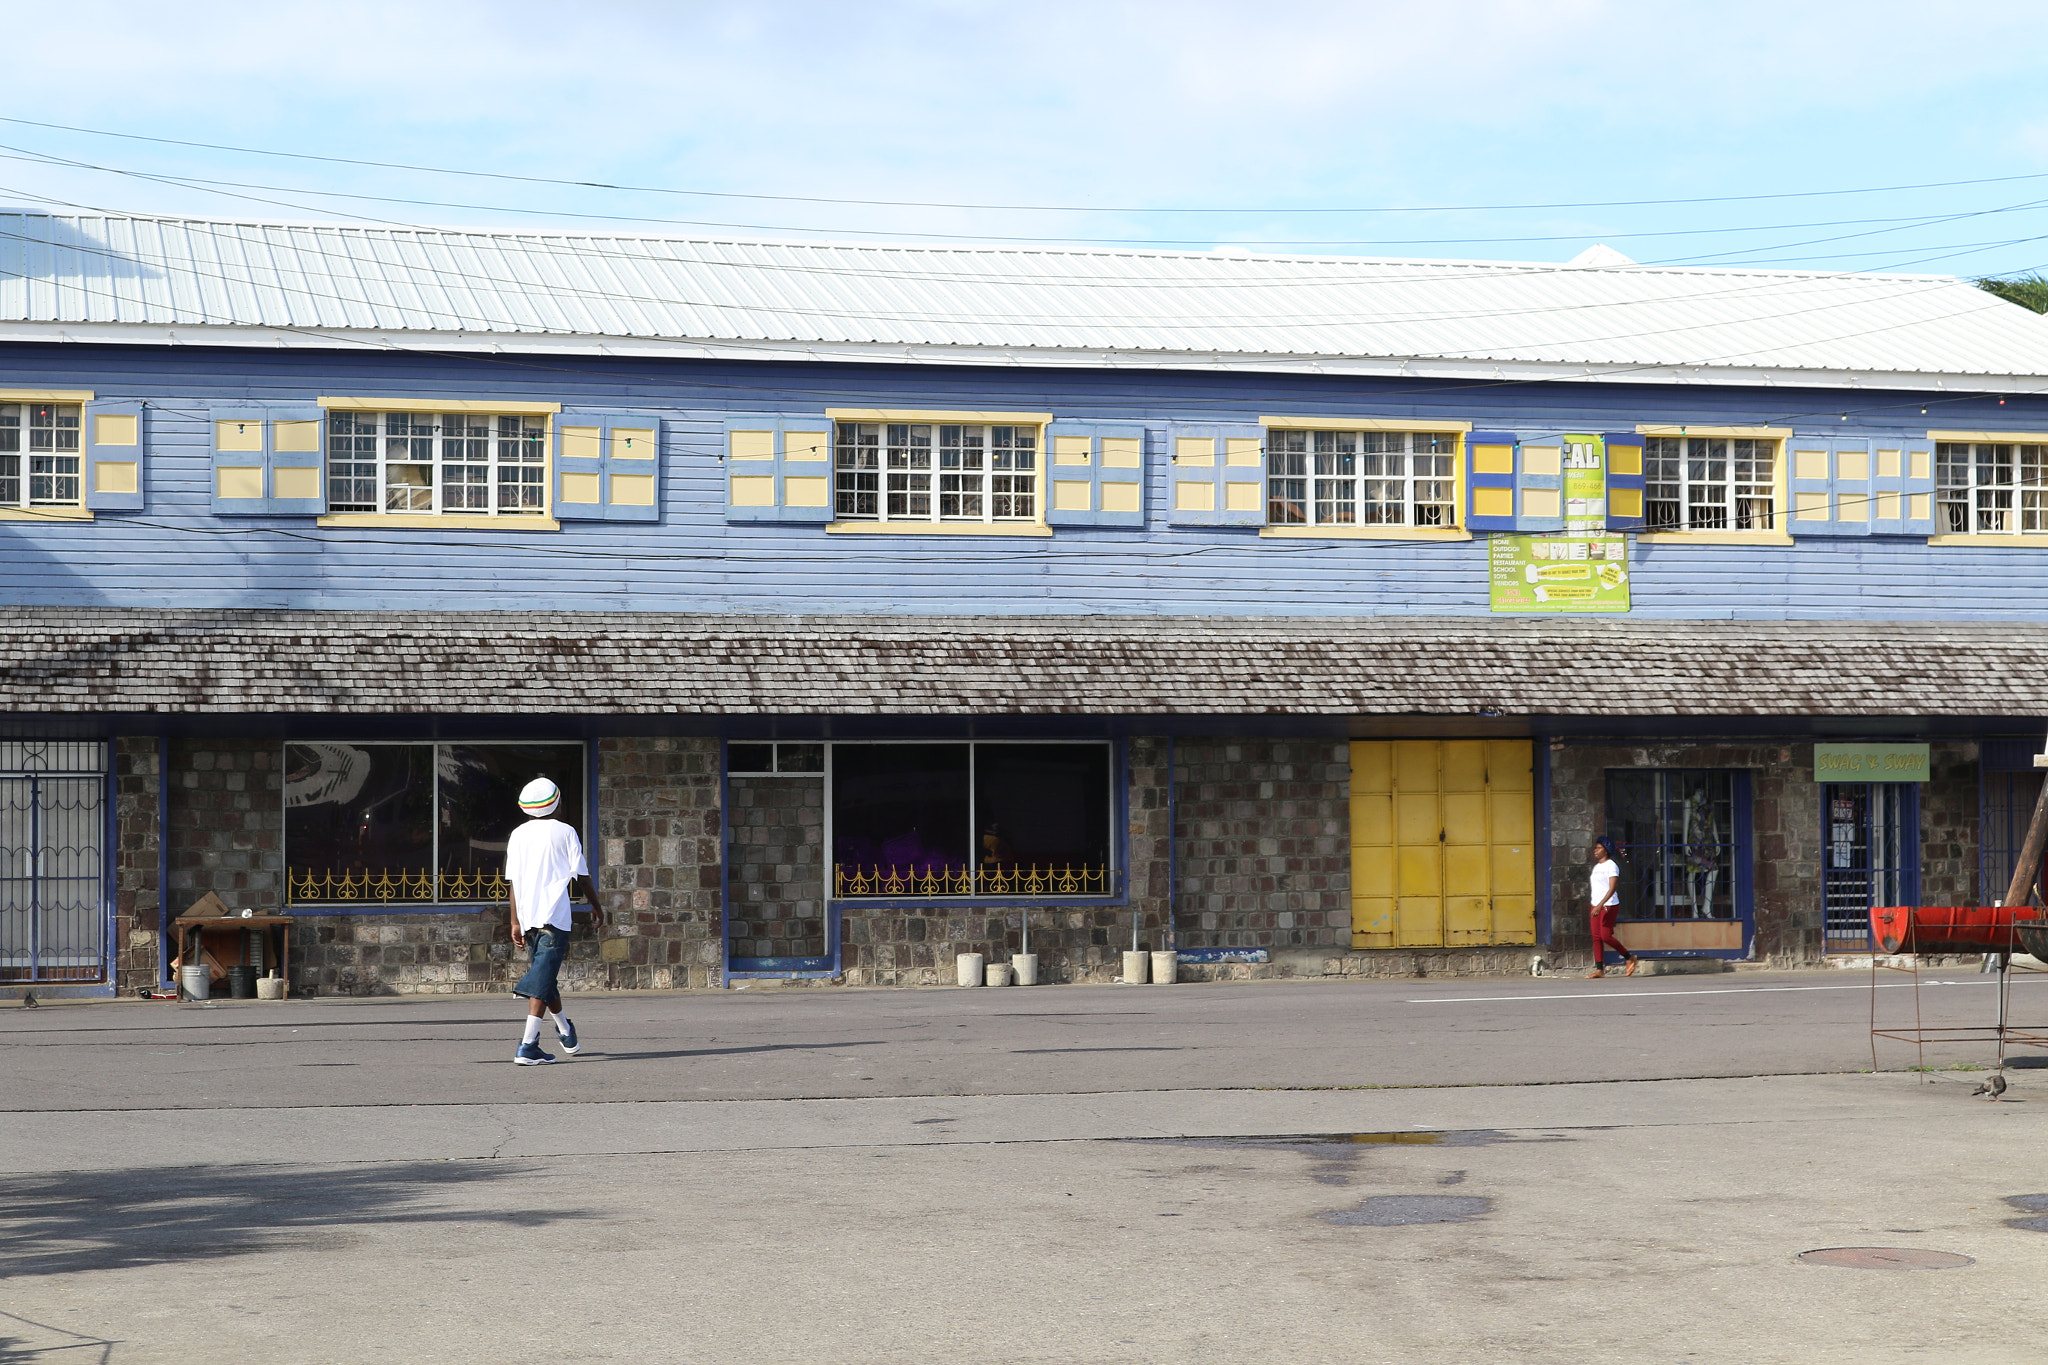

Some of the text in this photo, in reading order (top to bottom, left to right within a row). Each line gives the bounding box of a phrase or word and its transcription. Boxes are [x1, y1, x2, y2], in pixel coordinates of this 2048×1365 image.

[1819, 753, 1926, 771] SWAG & SWAY
